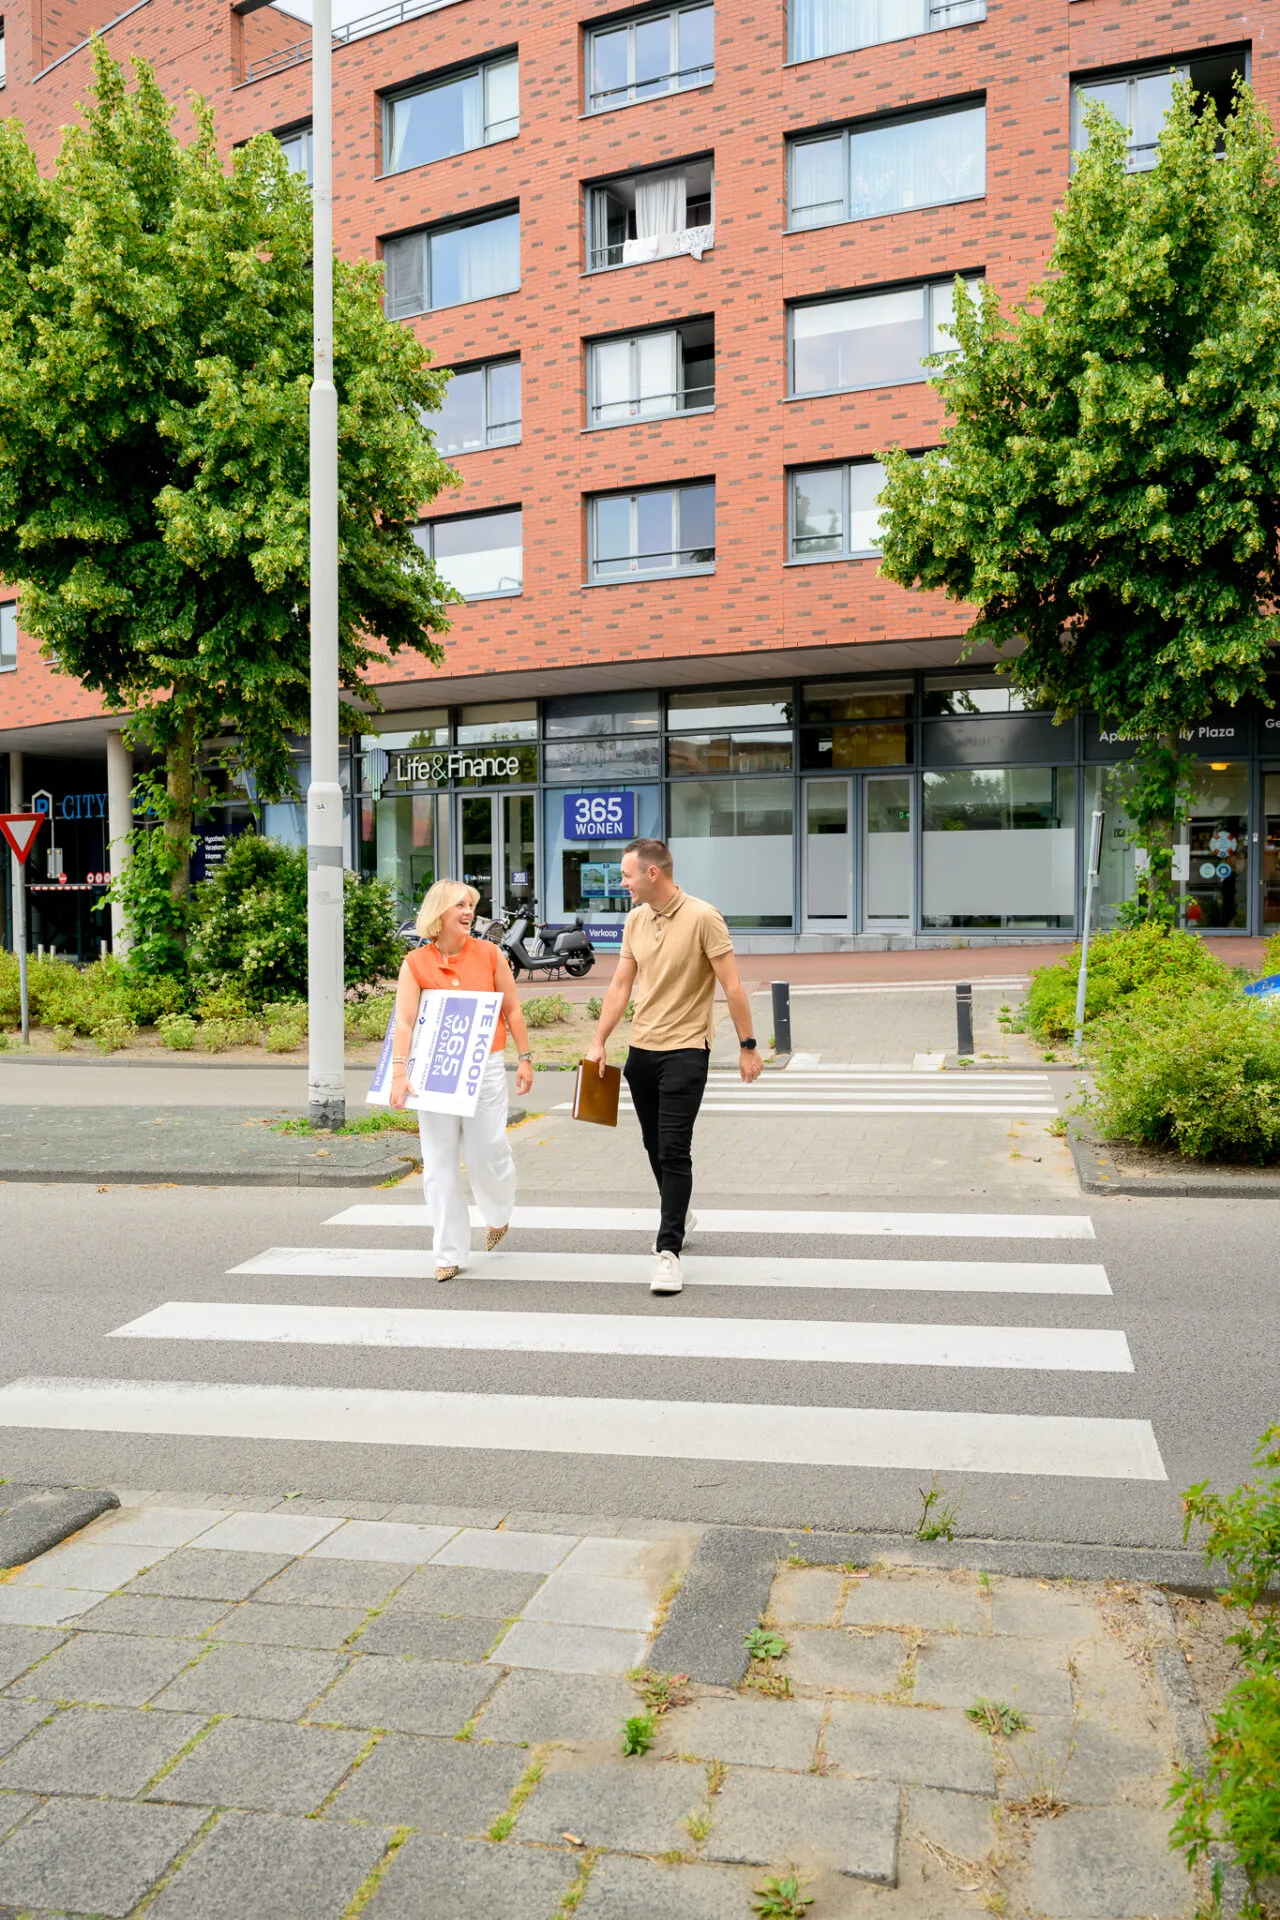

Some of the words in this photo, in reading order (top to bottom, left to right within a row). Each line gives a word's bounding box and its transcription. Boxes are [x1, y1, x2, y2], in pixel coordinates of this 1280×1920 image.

[1198, 726, 1235, 739] Plaza
[62, 793, 108, 820] CITY
[575, 797, 623, 823] 365
[575, 822, 623, 835] WONEN
[589, 929, 618, 939] Verkoop
[480, 999, 498, 1028] TE
[431, 1013, 454, 1076] WONEN
[440, 1014, 470, 1077] 365
[465, 1033, 490, 1097] KOOP
